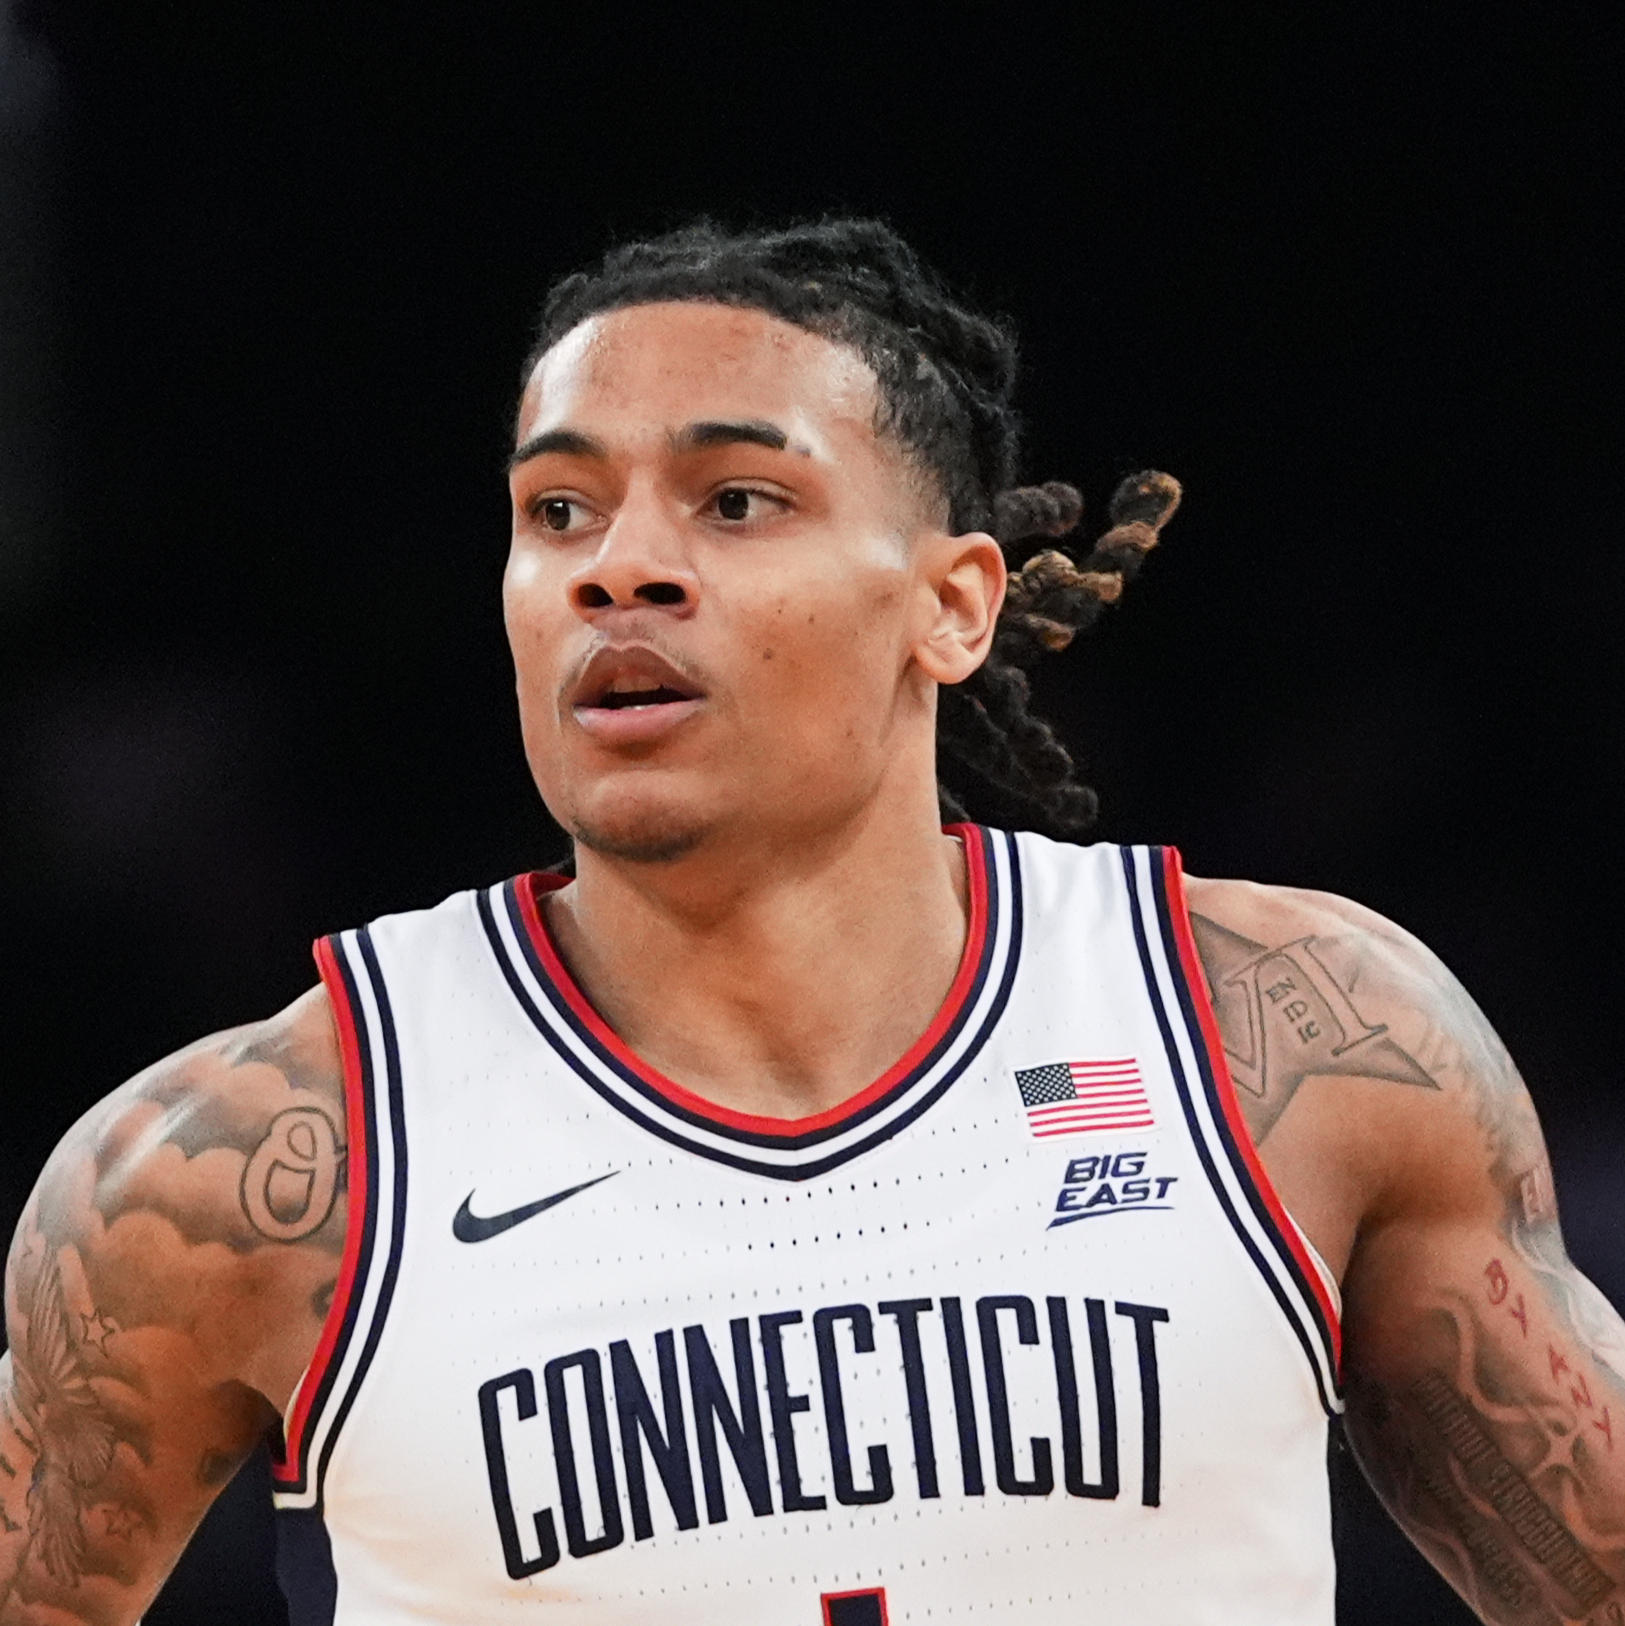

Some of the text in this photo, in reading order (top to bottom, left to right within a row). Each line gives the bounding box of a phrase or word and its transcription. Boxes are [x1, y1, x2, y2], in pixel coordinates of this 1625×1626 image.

[1063, 1152, 1148, 1184] BIG
[1055, 1177, 1178, 1212] EAST
[478, 1295, 1169, 1580] CONNECTICUT
